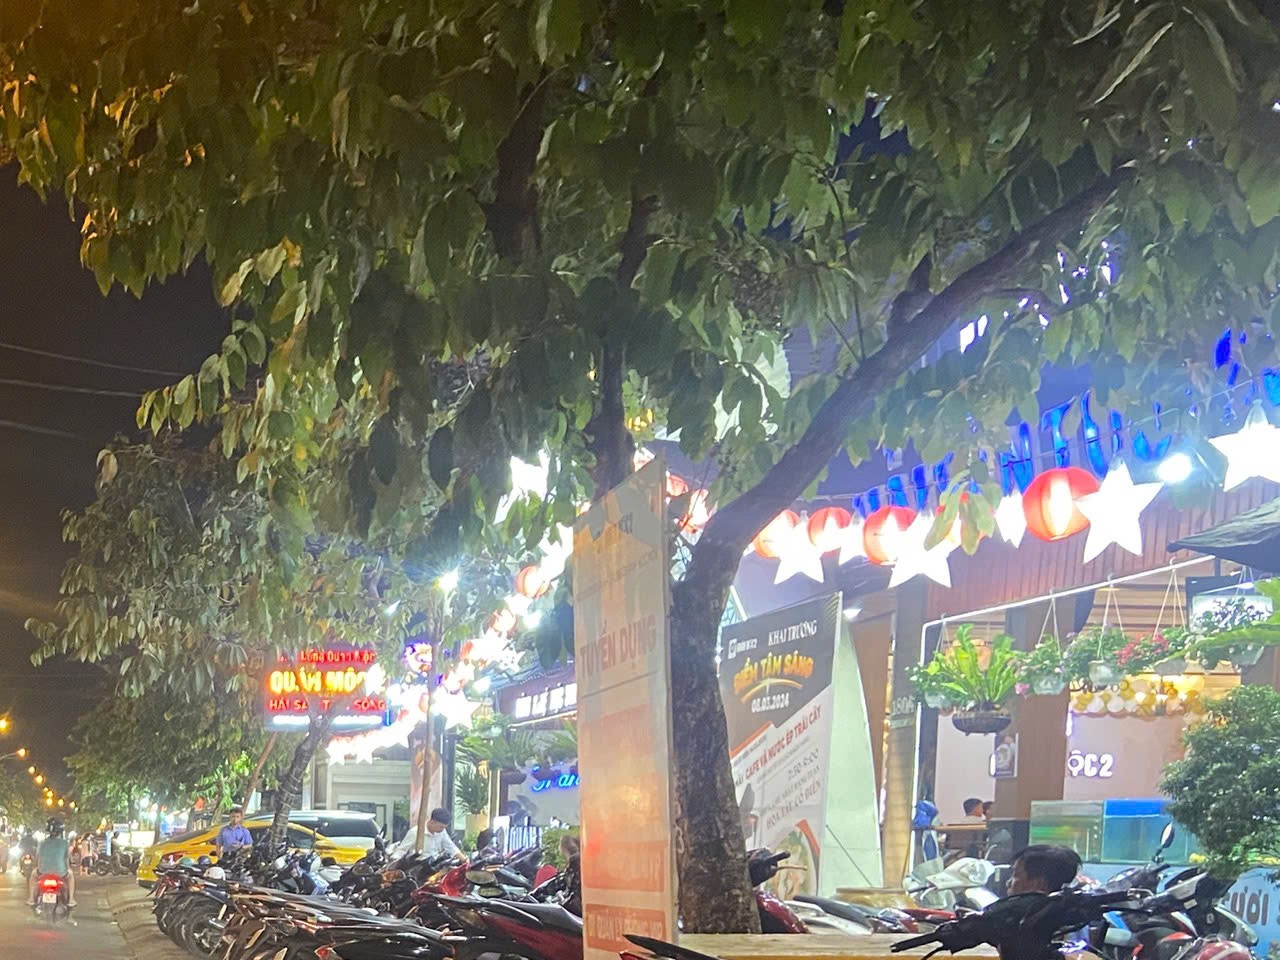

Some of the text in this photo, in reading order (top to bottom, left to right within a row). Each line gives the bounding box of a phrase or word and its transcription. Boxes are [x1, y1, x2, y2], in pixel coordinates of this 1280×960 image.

[580, 615, 657, 678] TUYỂN DỤNG
[1225, 886, 1269, 926] ƯƠI
